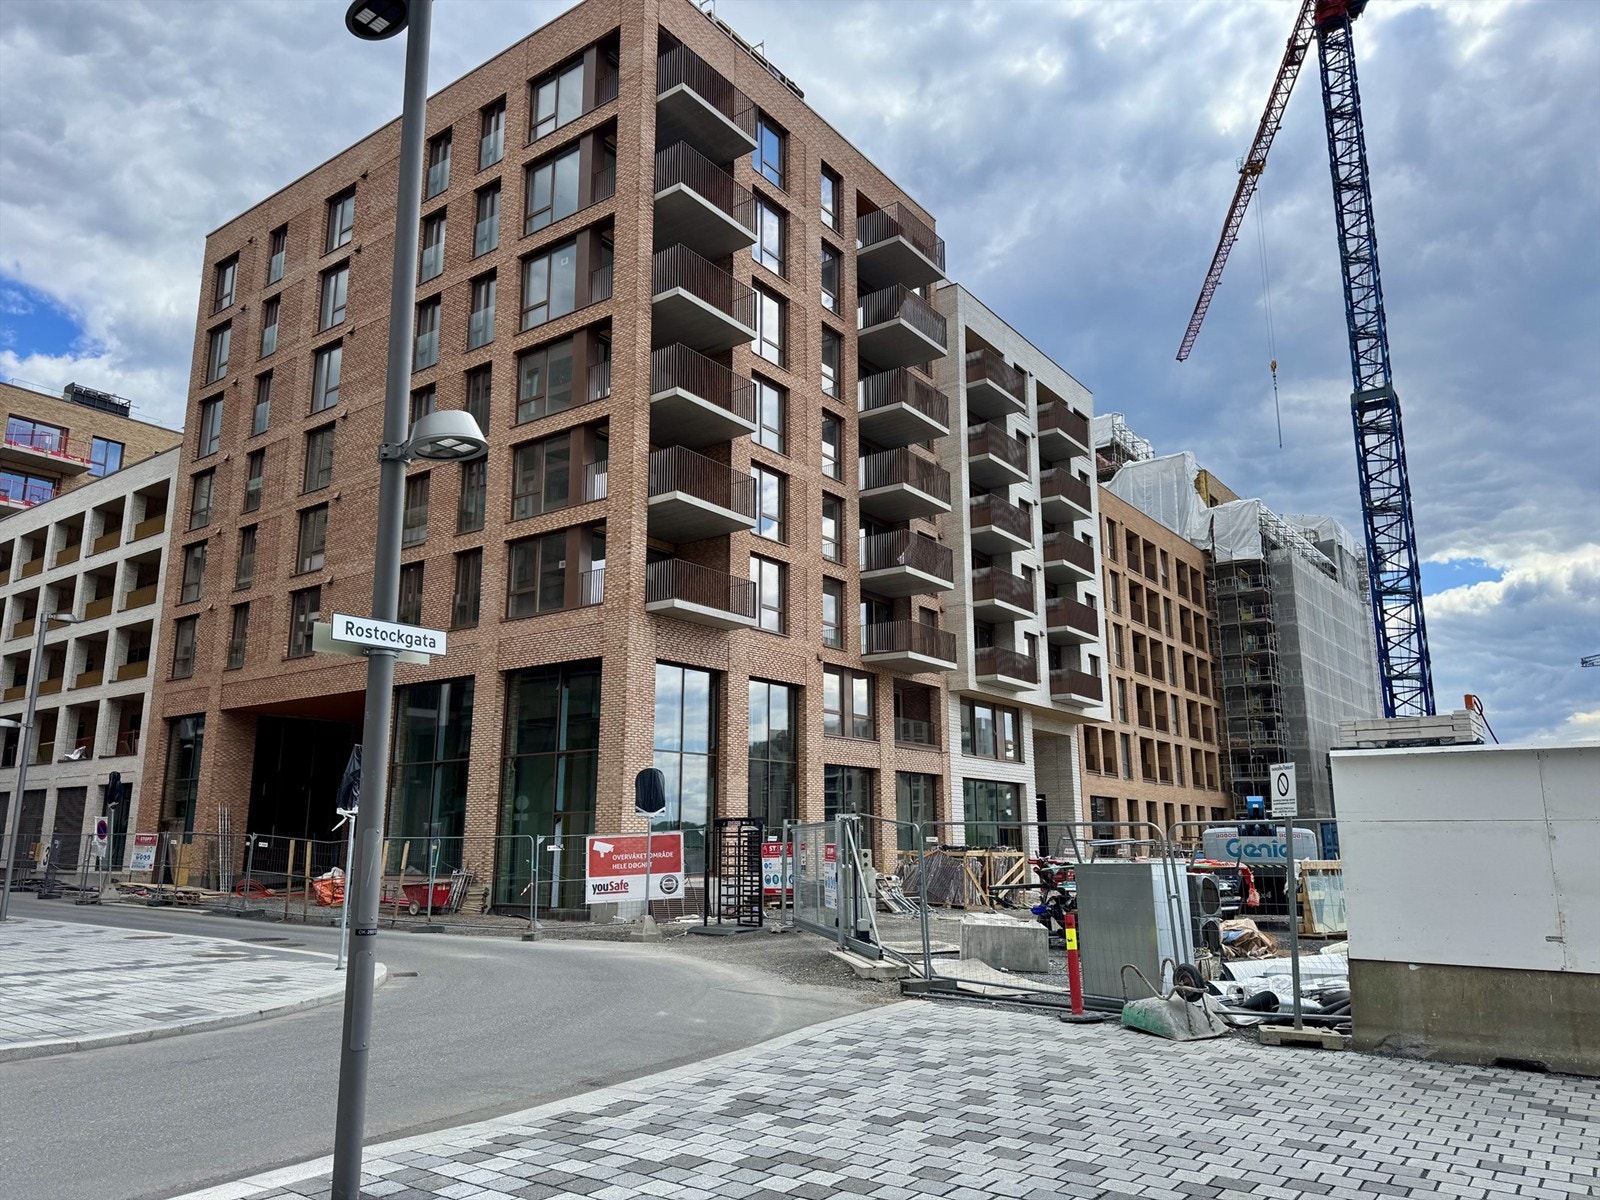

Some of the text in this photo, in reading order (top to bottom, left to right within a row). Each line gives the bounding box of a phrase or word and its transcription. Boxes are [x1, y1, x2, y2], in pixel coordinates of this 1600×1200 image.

[345, 621, 436, 648] Rostockgata
[612, 852, 647, 861] OVERVÅKET
[612, 862, 627, 870] HELE
[592, 879, 629, 895] youSafe
